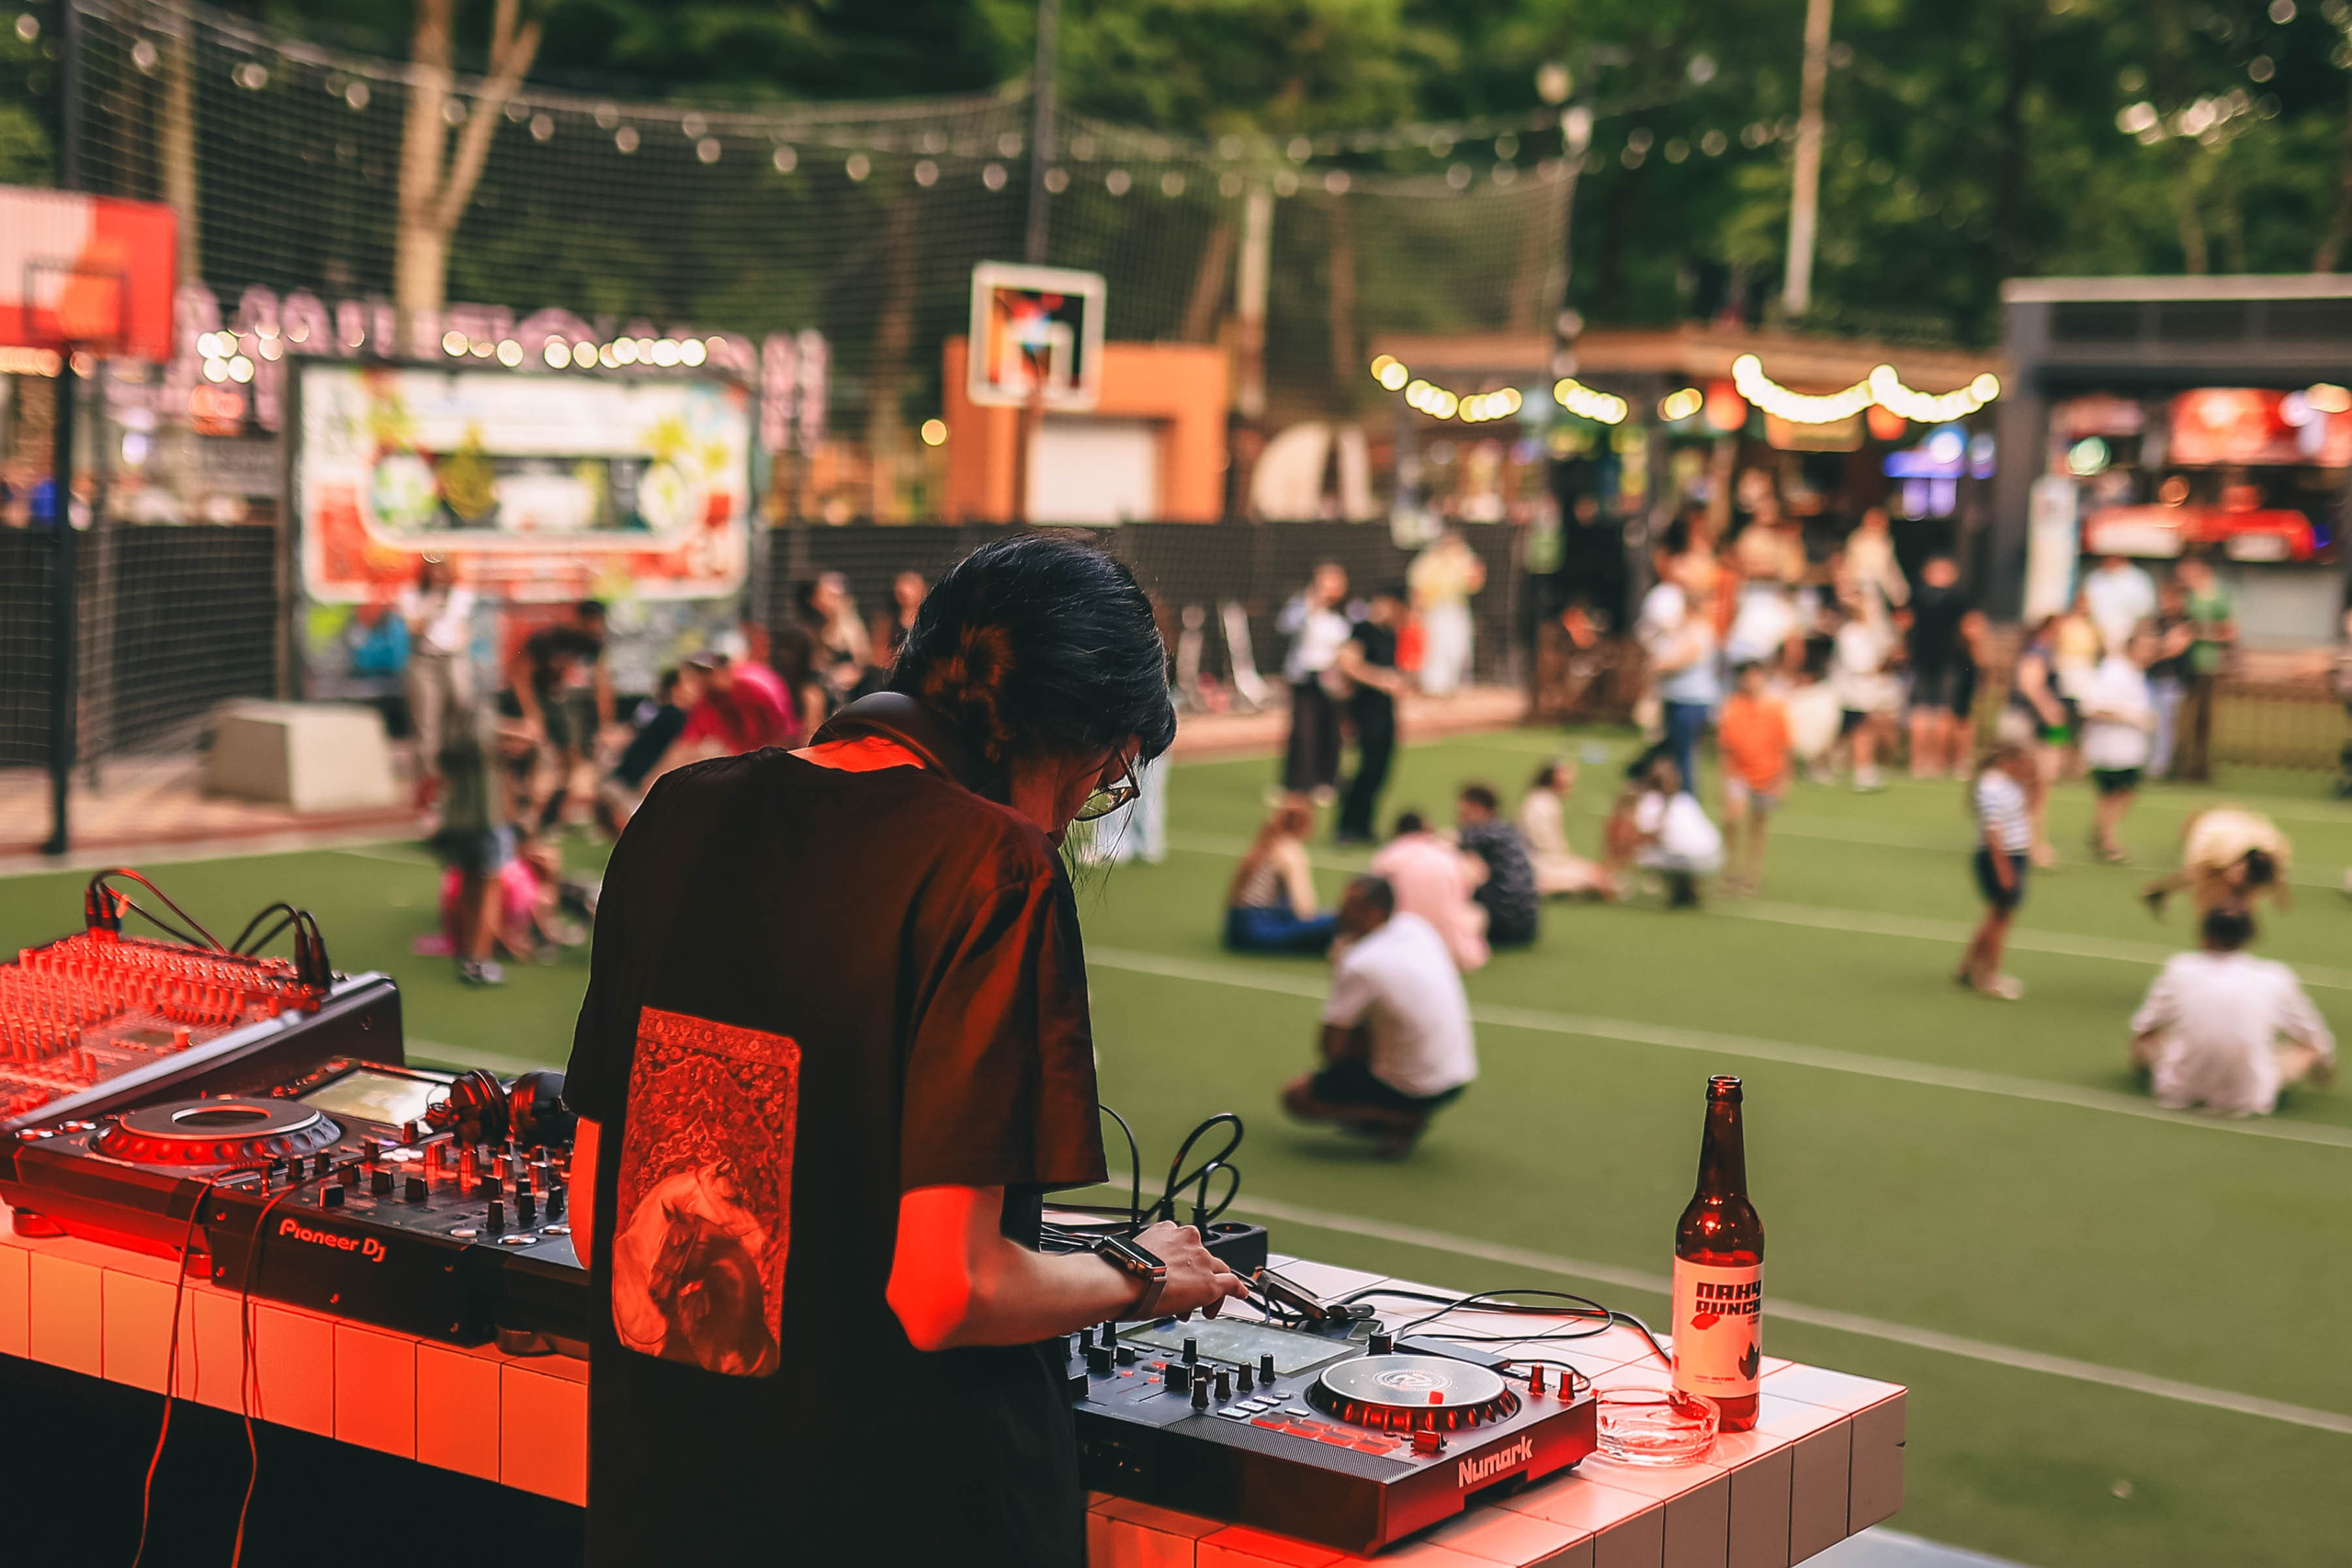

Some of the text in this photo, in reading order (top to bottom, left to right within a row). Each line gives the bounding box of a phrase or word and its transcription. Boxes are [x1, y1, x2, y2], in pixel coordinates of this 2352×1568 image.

[278, 1218, 387, 1262] Pioneer DJ
[1696, 1298, 1761, 1315] PUNCH
[1458, 1435, 1533, 1488] Numark
